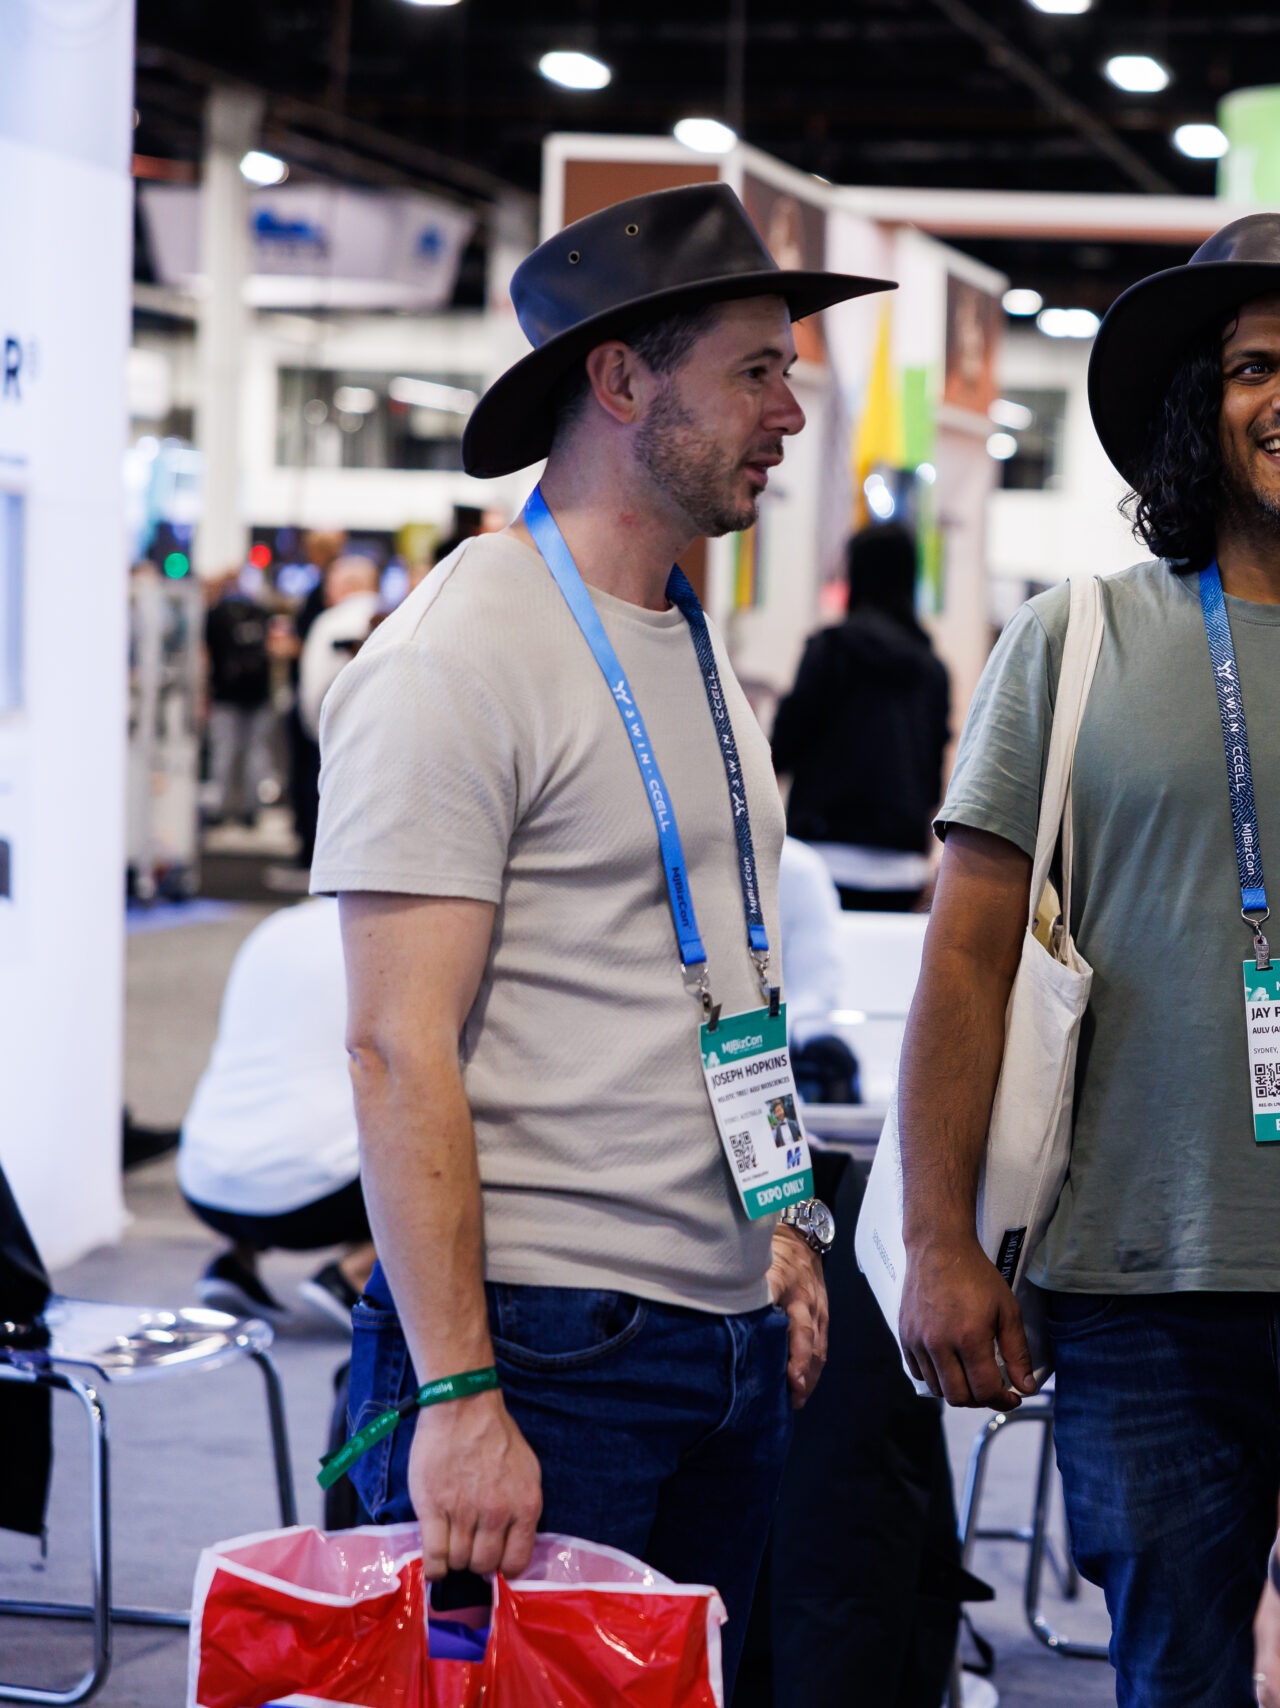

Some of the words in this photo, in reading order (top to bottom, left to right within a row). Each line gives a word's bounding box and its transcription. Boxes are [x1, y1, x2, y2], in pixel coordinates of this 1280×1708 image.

[1232, 746, 1246, 792] CCELL
[649, 779, 671, 833] CCELL
[1241, 823, 1255, 876] MJBizCon
[671, 867, 689, 927] MJBizCon
[1251, 1007, 1271, 1021] JAY
[1252, 1026, 1270, 1035] AULV
[1253, 1046, 1279, 1054] SYDNEY,
[711, 1067, 744, 1088] JOSEPH
[746, 1054, 788, 1077] HOPKINS
[756, 1185, 782, 1206] EXPO
[782, 1178, 805, 1198] ONLY
